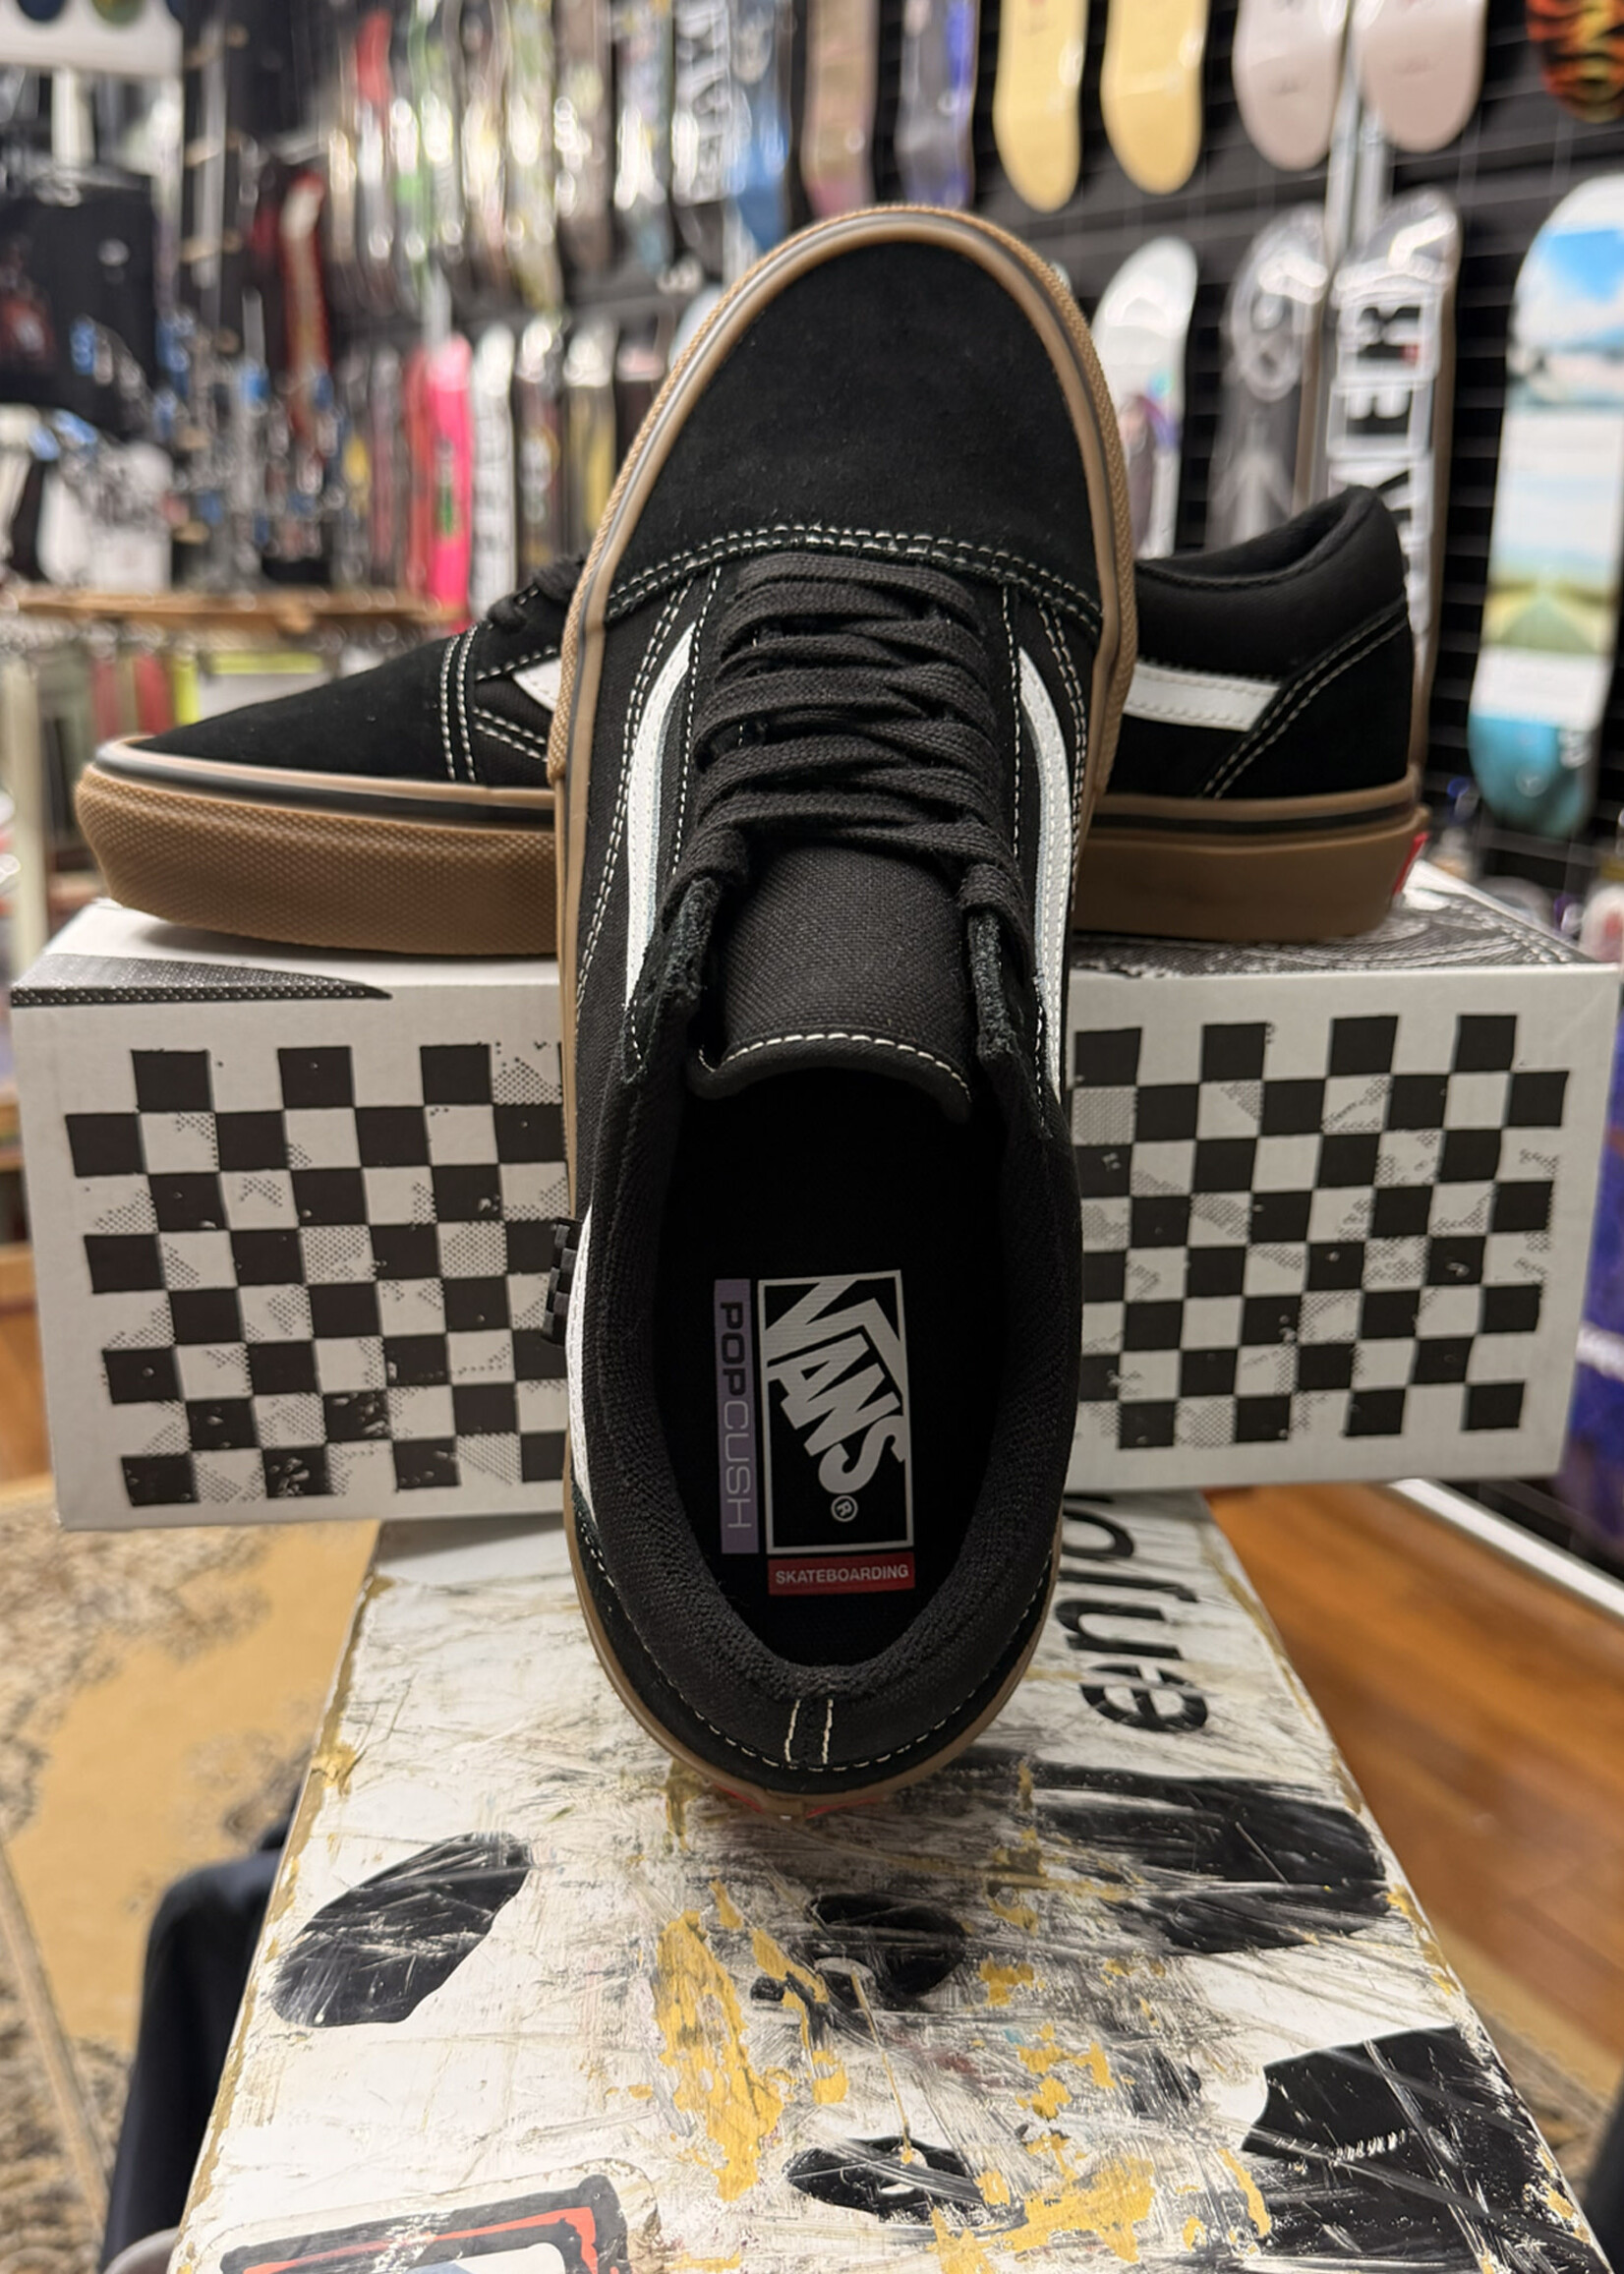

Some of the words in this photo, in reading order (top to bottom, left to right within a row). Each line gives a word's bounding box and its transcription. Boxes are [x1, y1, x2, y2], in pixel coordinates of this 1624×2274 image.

[720, 1301, 753, 1530] POPCUSH
[764, 1279, 908, 1495] VANS
[775, 1563, 909, 1586] SKATEBOARDING
